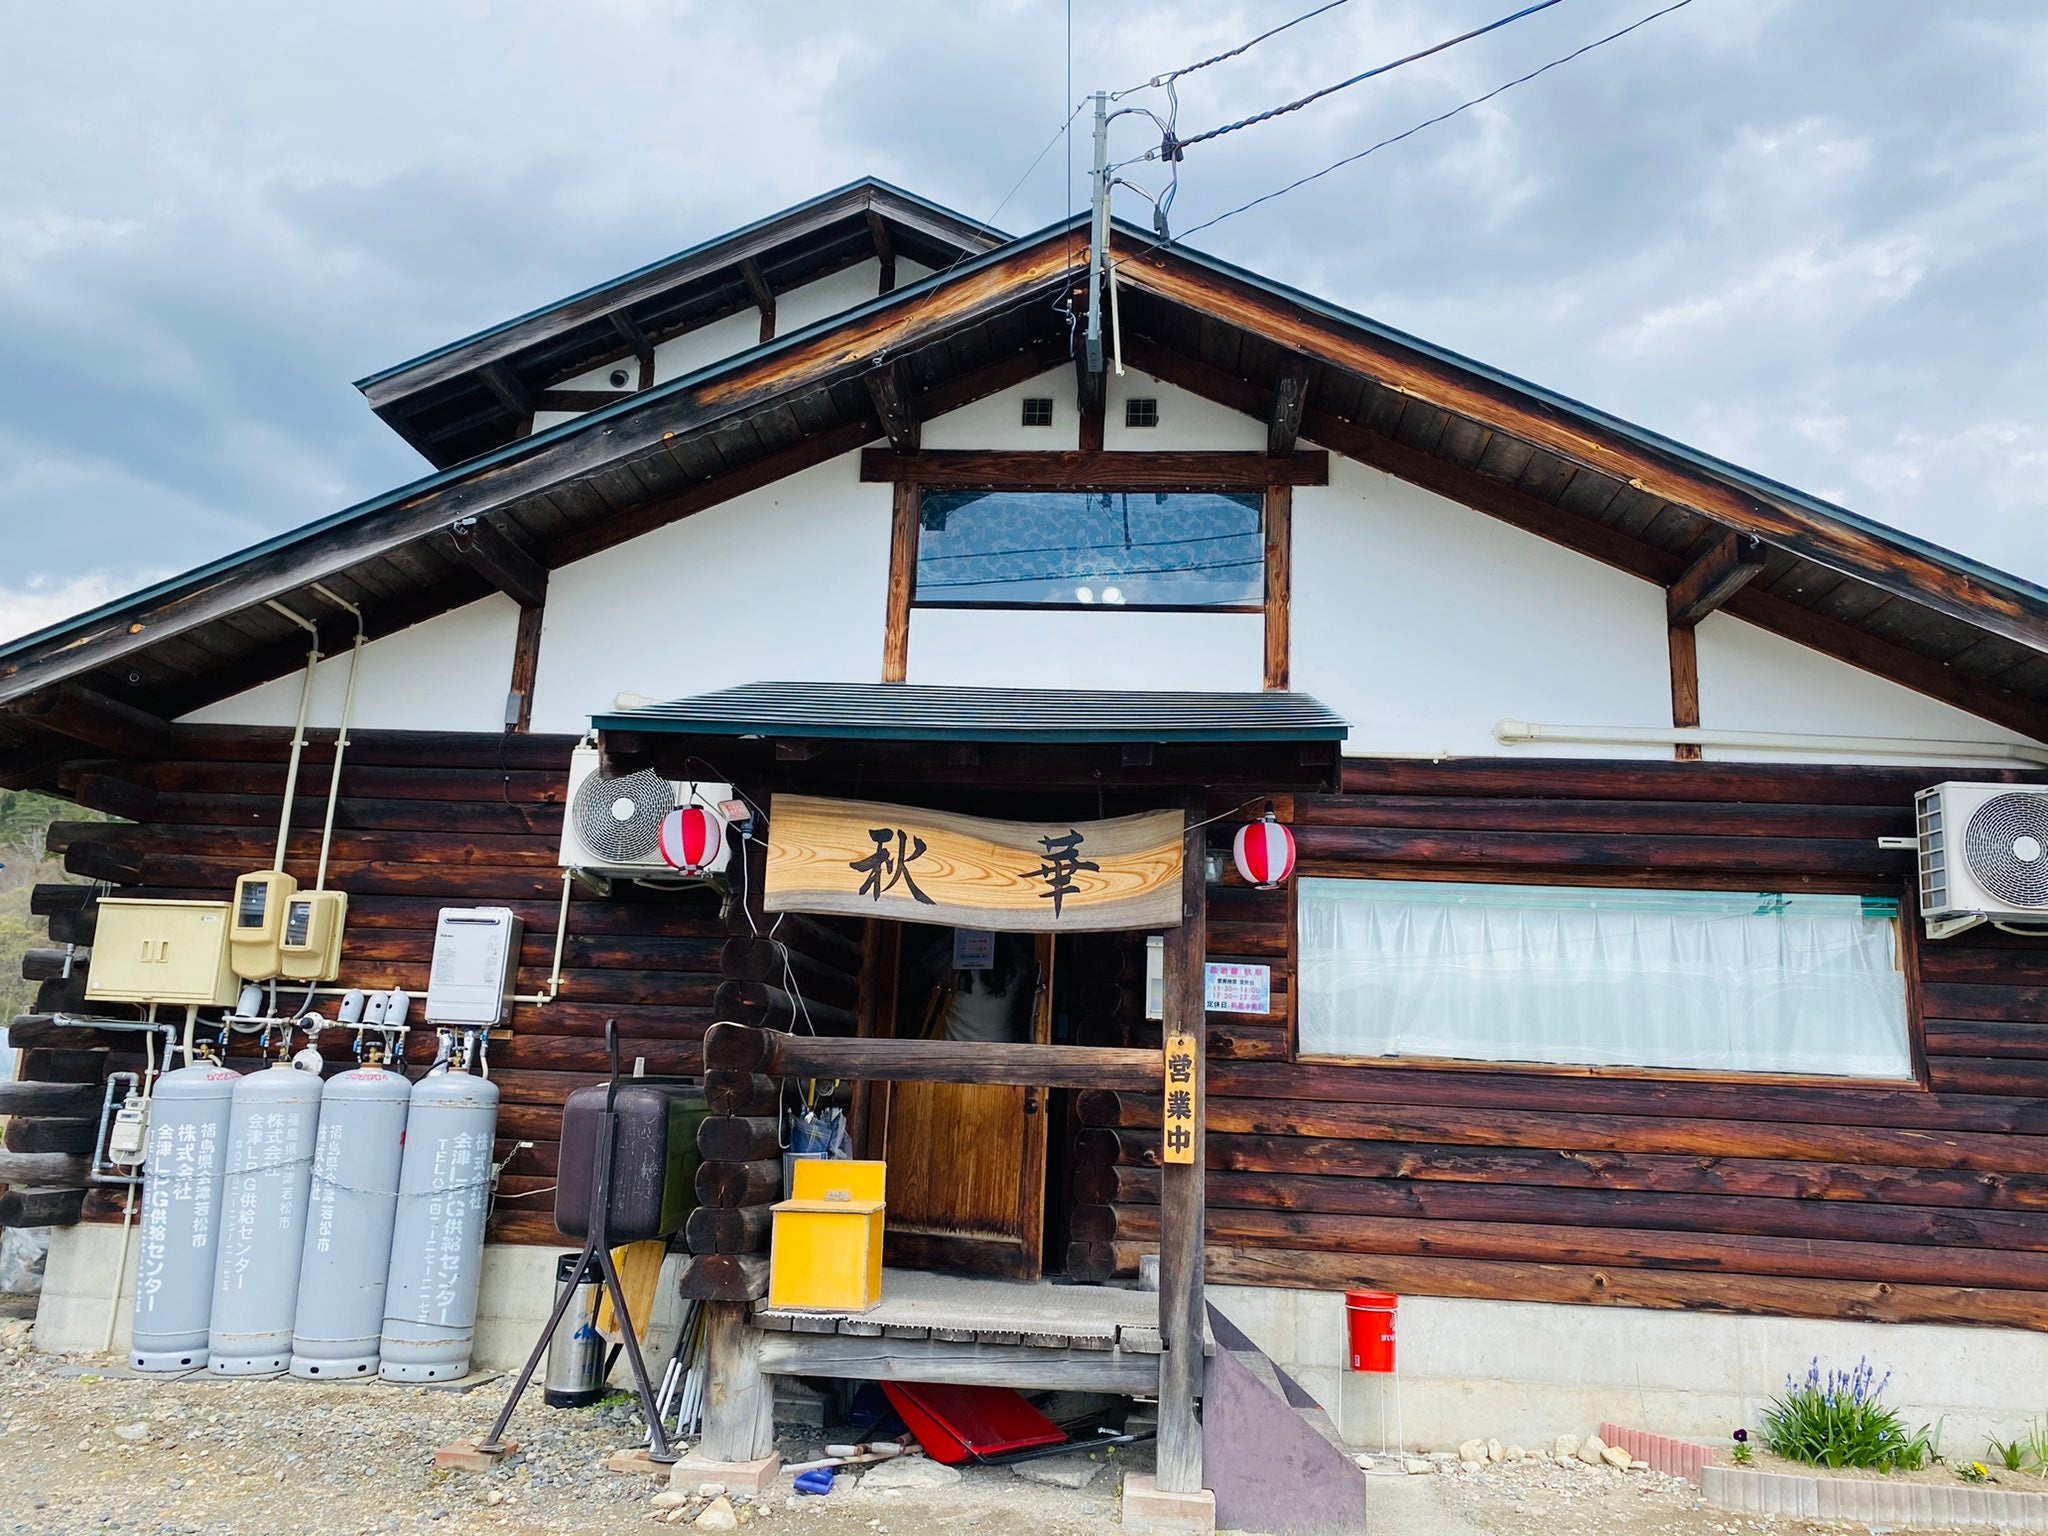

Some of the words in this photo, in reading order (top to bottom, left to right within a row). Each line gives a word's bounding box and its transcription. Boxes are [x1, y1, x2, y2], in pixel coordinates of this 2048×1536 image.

[264, 1113, 285, 1177] 株式会社
[1167, 1054, 1192, 1154] 営業中
[173, 1124, 197, 1201] 株式会社
[192, 1123, 217, 1248] 福島県会津若松市
[235, 1113, 264, 1289] 会津LPG供給センター
[279, 1113, 300, 1229] 福島県会津若松市
[317, 1125, 342, 1252] 福島県会津若松市
